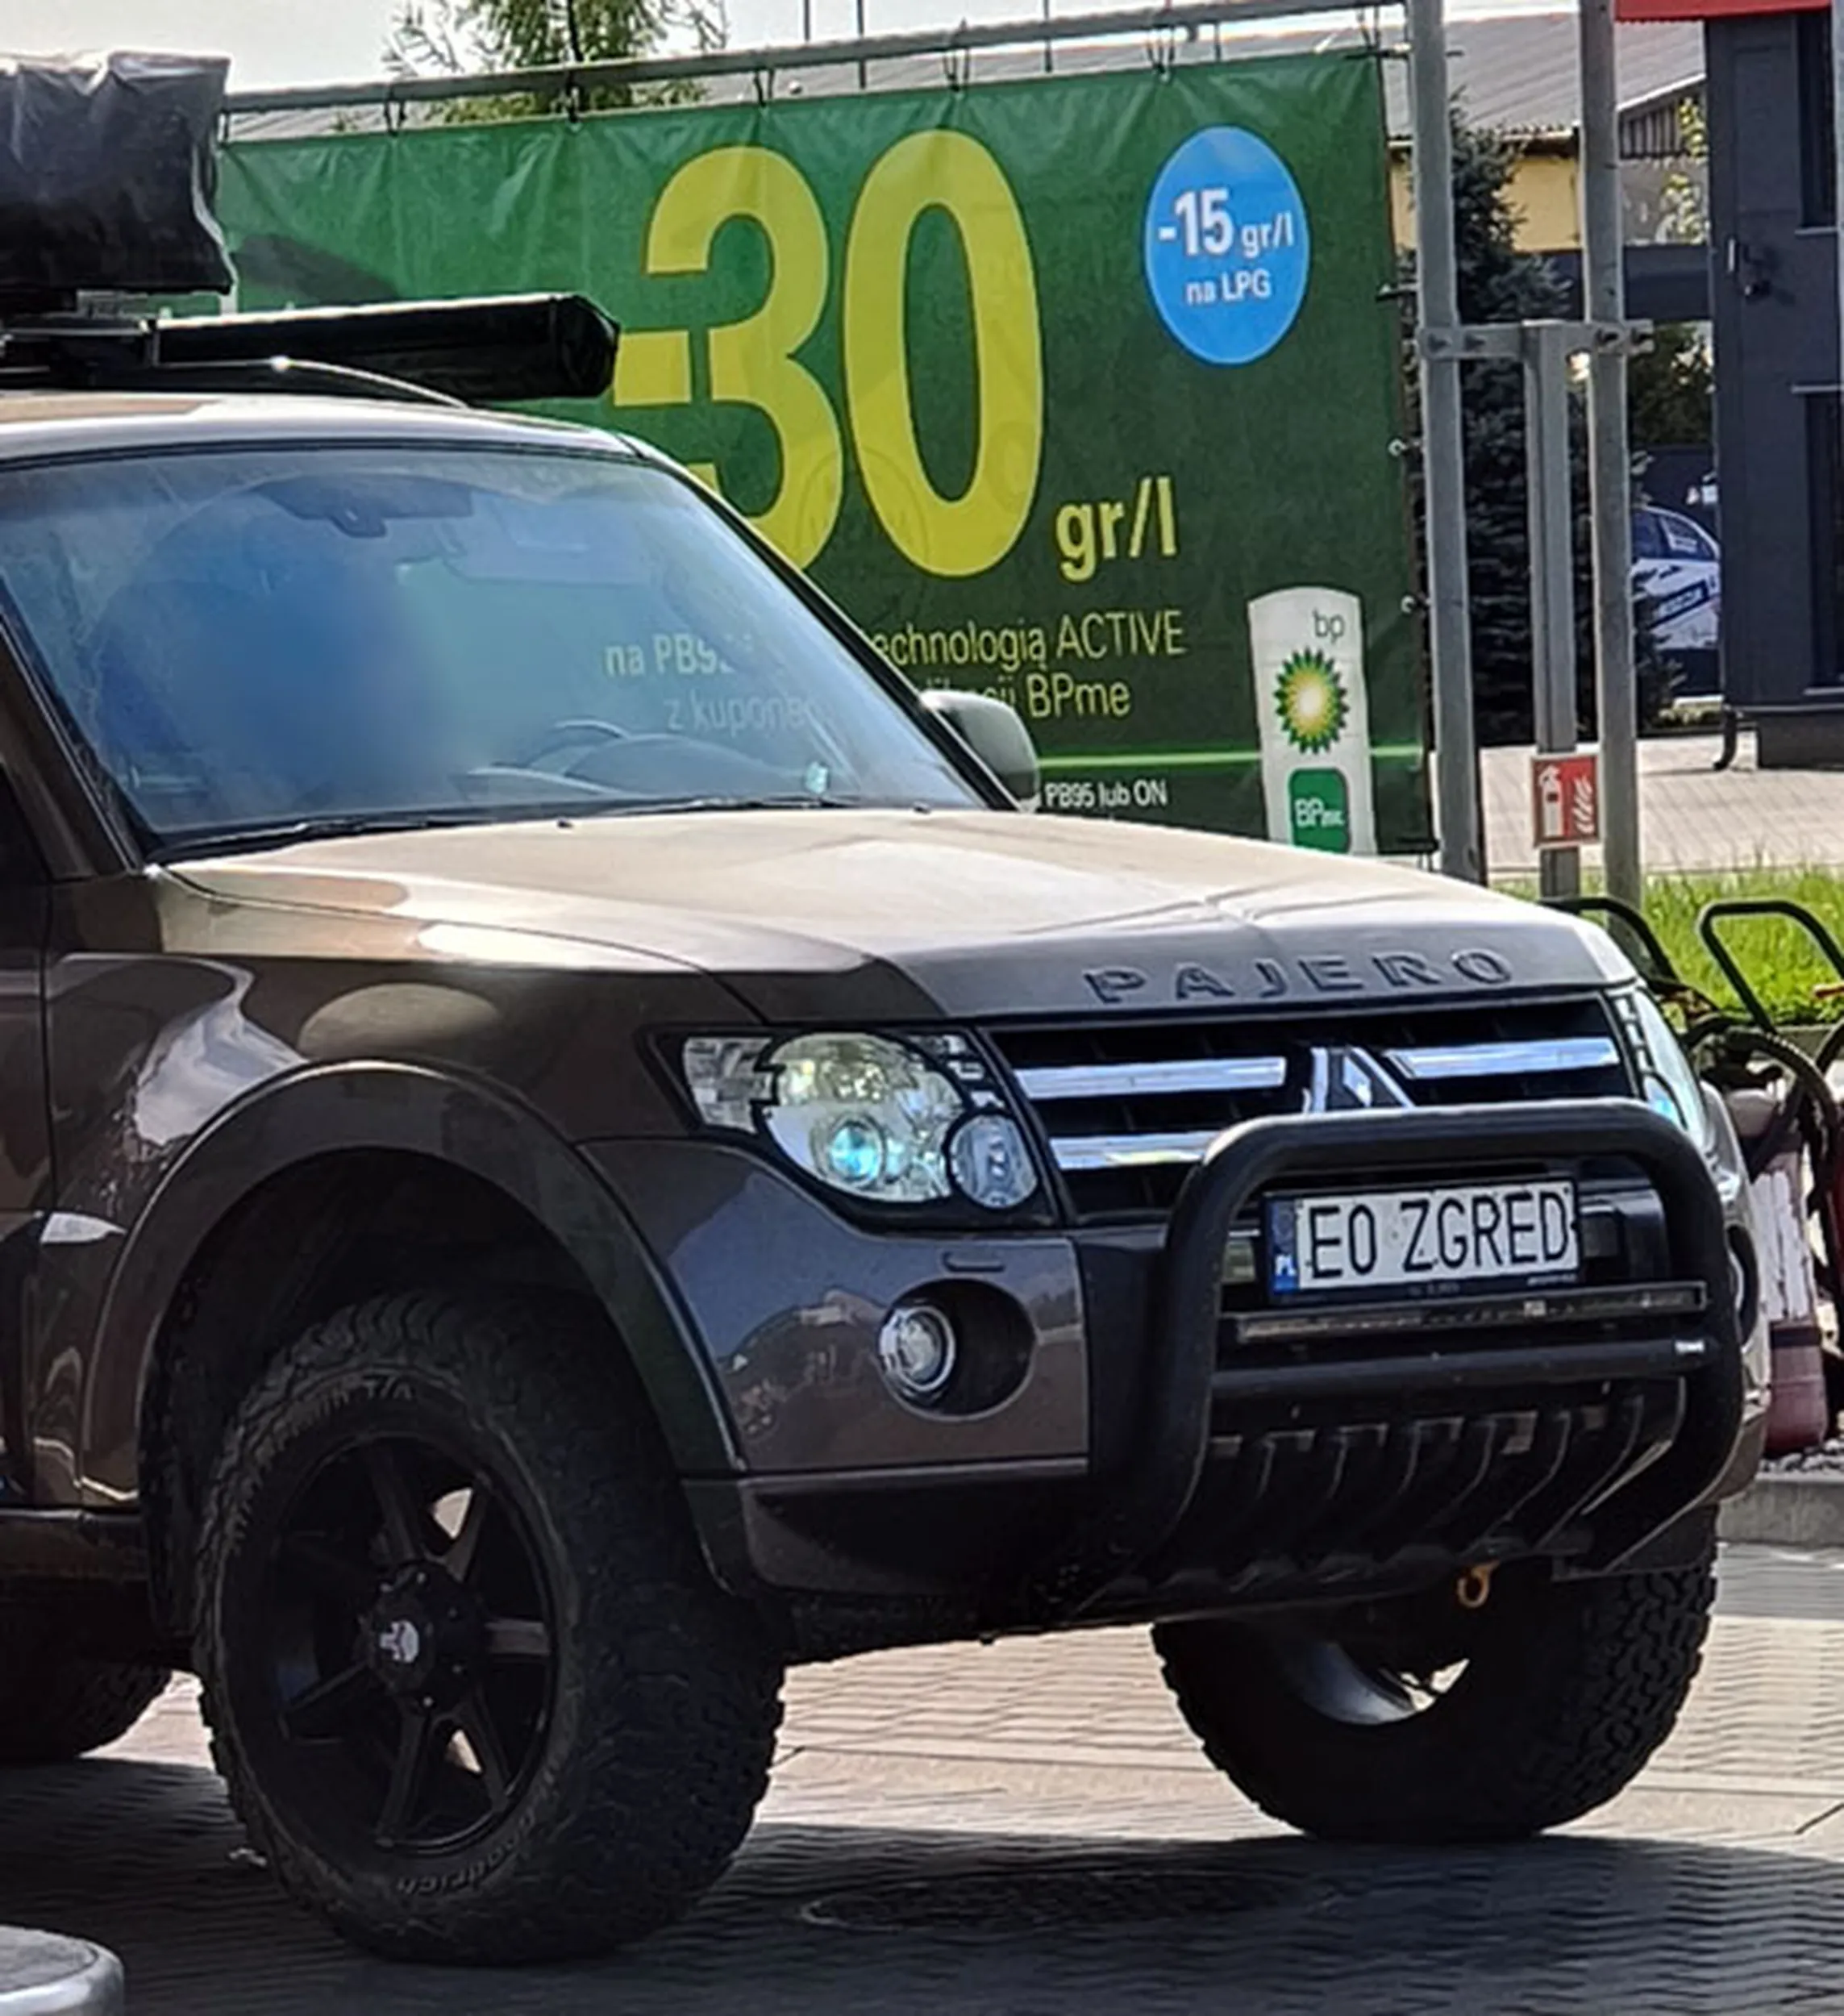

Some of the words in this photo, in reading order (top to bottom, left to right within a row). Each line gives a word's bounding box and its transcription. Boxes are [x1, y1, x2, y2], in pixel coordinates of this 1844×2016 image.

[1159, 186, 1234, 257] -15
[1241, 210, 1296, 259] gr/l
[1186, 279, 1216, 306] na
[1221, 268, 1272, 302] LPG
[1055, 476, 1177, 582] gr/l
[606, 644, 645, 677] na
[871, 619, 1047, 672] echnologią
[1055, 610, 1188, 660] ACTIVE
[1311, 606, 1346, 645] bp
[664, 698, 685, 731] z
[689, 689, 808, 737] kupone
[1025, 673, 1131, 719] BPme
[1045, 782, 1095, 807] PB95
[1097, 780, 1129, 806] lub
[1133, 779, 1168, 806] ON
[1082, 949, 1513, 1005] PAJERO
[1399, 1189, 1571, 1273] ZGRED
